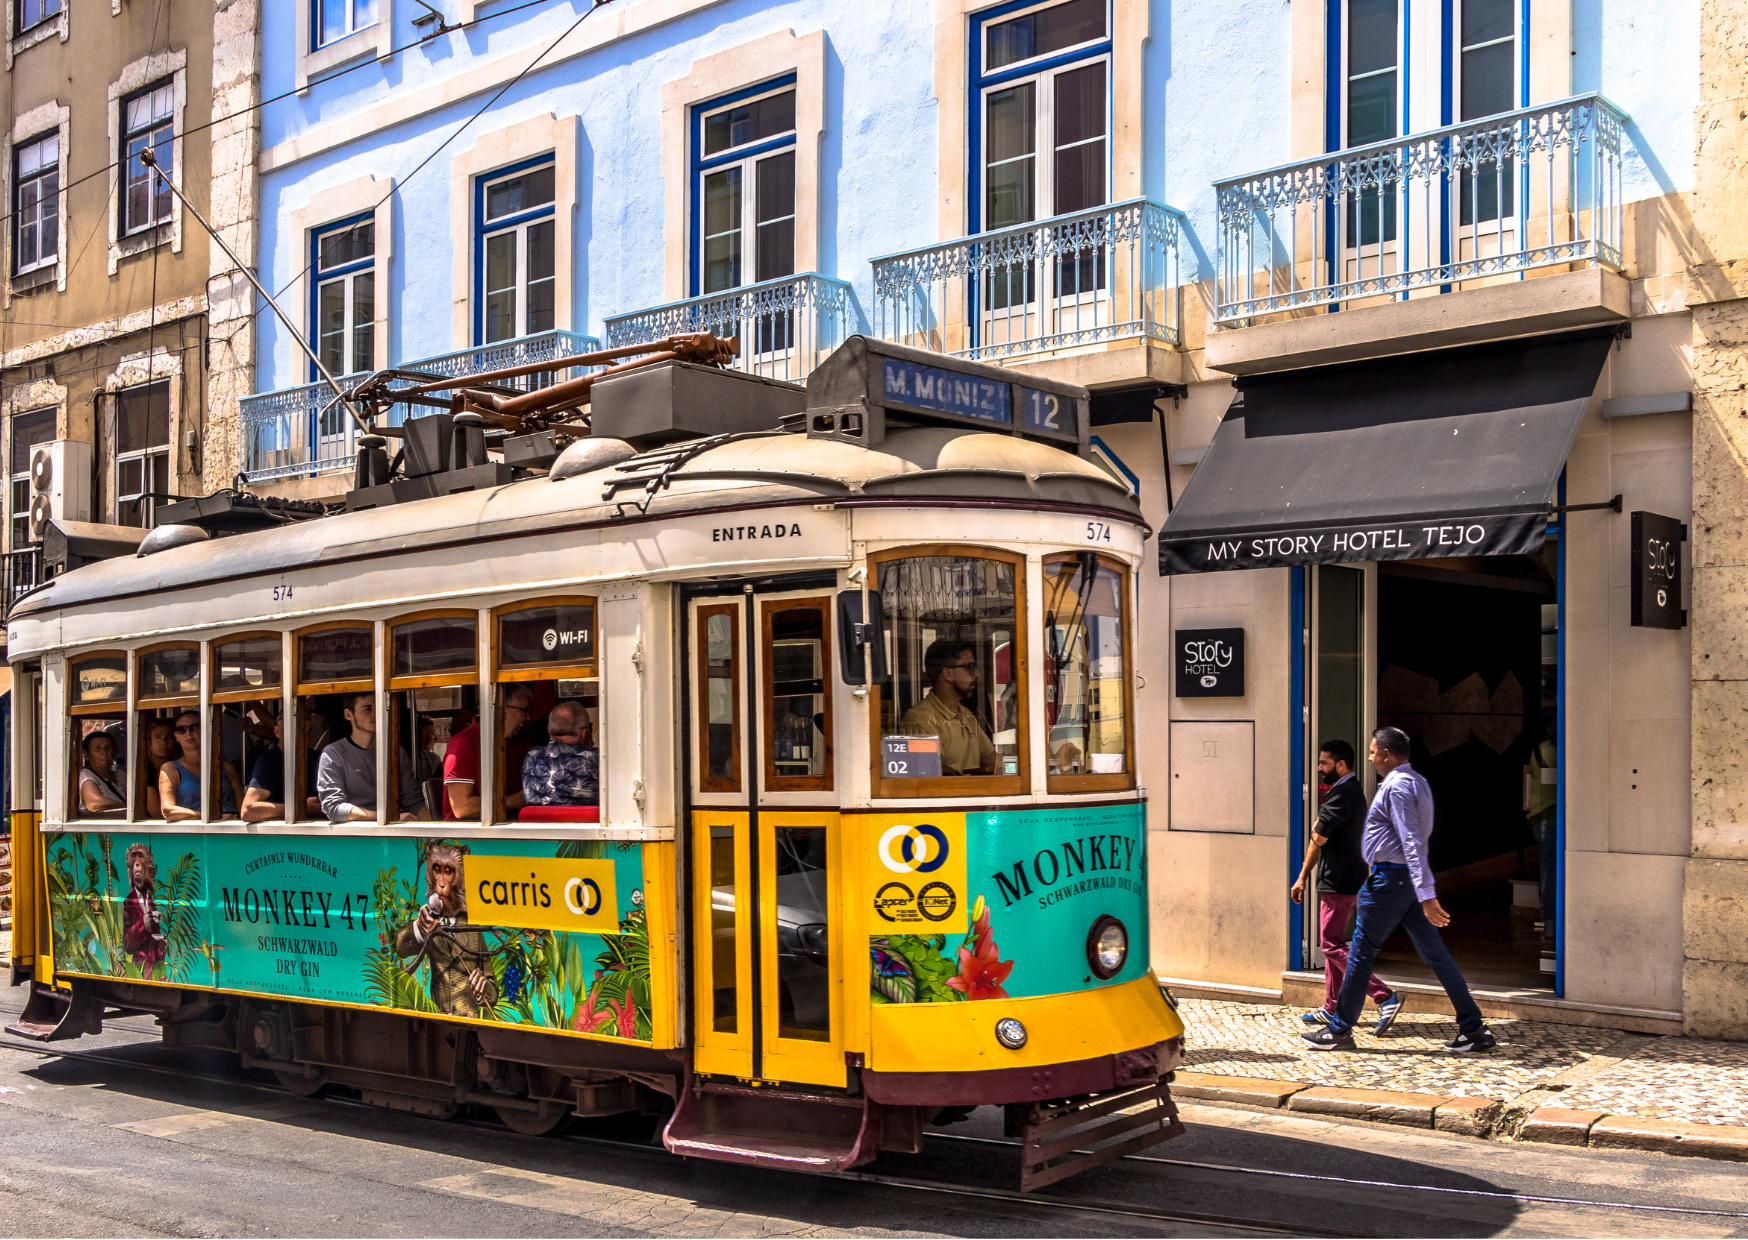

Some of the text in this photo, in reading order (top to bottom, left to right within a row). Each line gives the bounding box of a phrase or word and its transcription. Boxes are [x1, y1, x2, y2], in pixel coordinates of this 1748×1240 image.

[1031, 391, 1059, 429] 12
[712, 523, 802, 542] ENTRADA
[1086, 522, 1111, 542] 574
[1207, 524, 1485, 560] MY STORY HOTEL TEJO
[273, 585, 293, 601] 574
[559, 629, 588, 645] WI-FI
[1185, 664, 1221, 675] HOTEL
[90, 678, 107, 688] WI-FI
[887, 743, 907, 753] 12E
[887, 760, 908, 774] 02
[245, 852, 338, 879] CERTAINLY WUNDERBAR
[991, 835, 1136, 907] MONKEY
[479, 872, 551, 908] carris
[1038, 876, 1116, 910] SCHWARZWALD
[1118, 877, 1132, 891] DRY
[222, 887, 369, 932] MONKEY 47
[258, 935, 338, 957] SCHWARZWALD
[276, 958, 320, 977] DRY GIN
